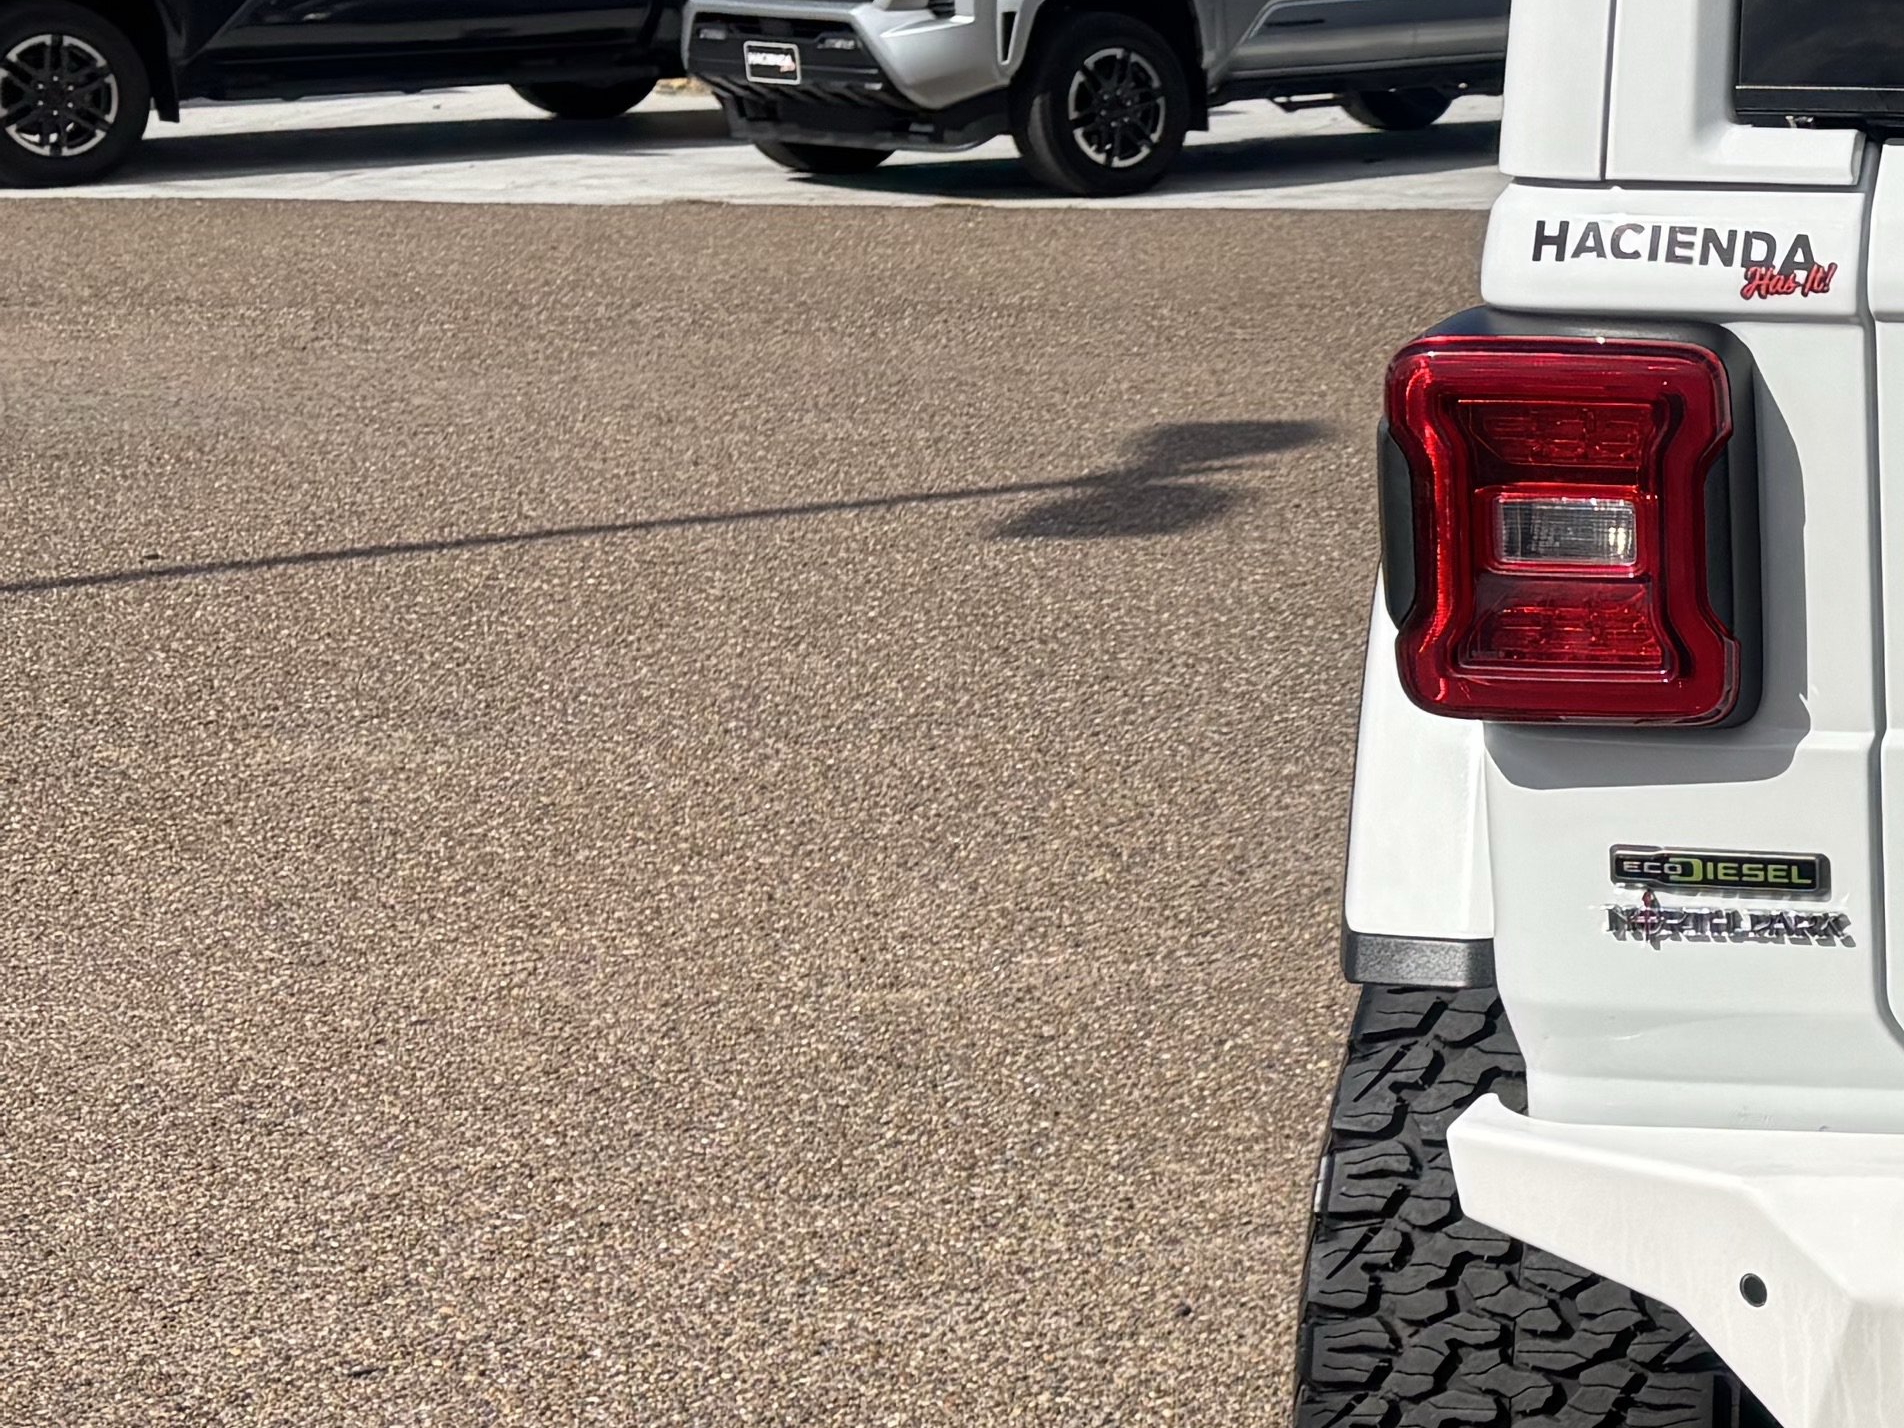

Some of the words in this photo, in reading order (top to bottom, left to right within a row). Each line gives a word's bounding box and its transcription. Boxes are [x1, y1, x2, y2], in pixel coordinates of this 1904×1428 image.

[1531, 219, 1817, 274] HACIENDA
[1740, 265, 1796, 300] Has
[1800, 260, 1839, 298] It!
